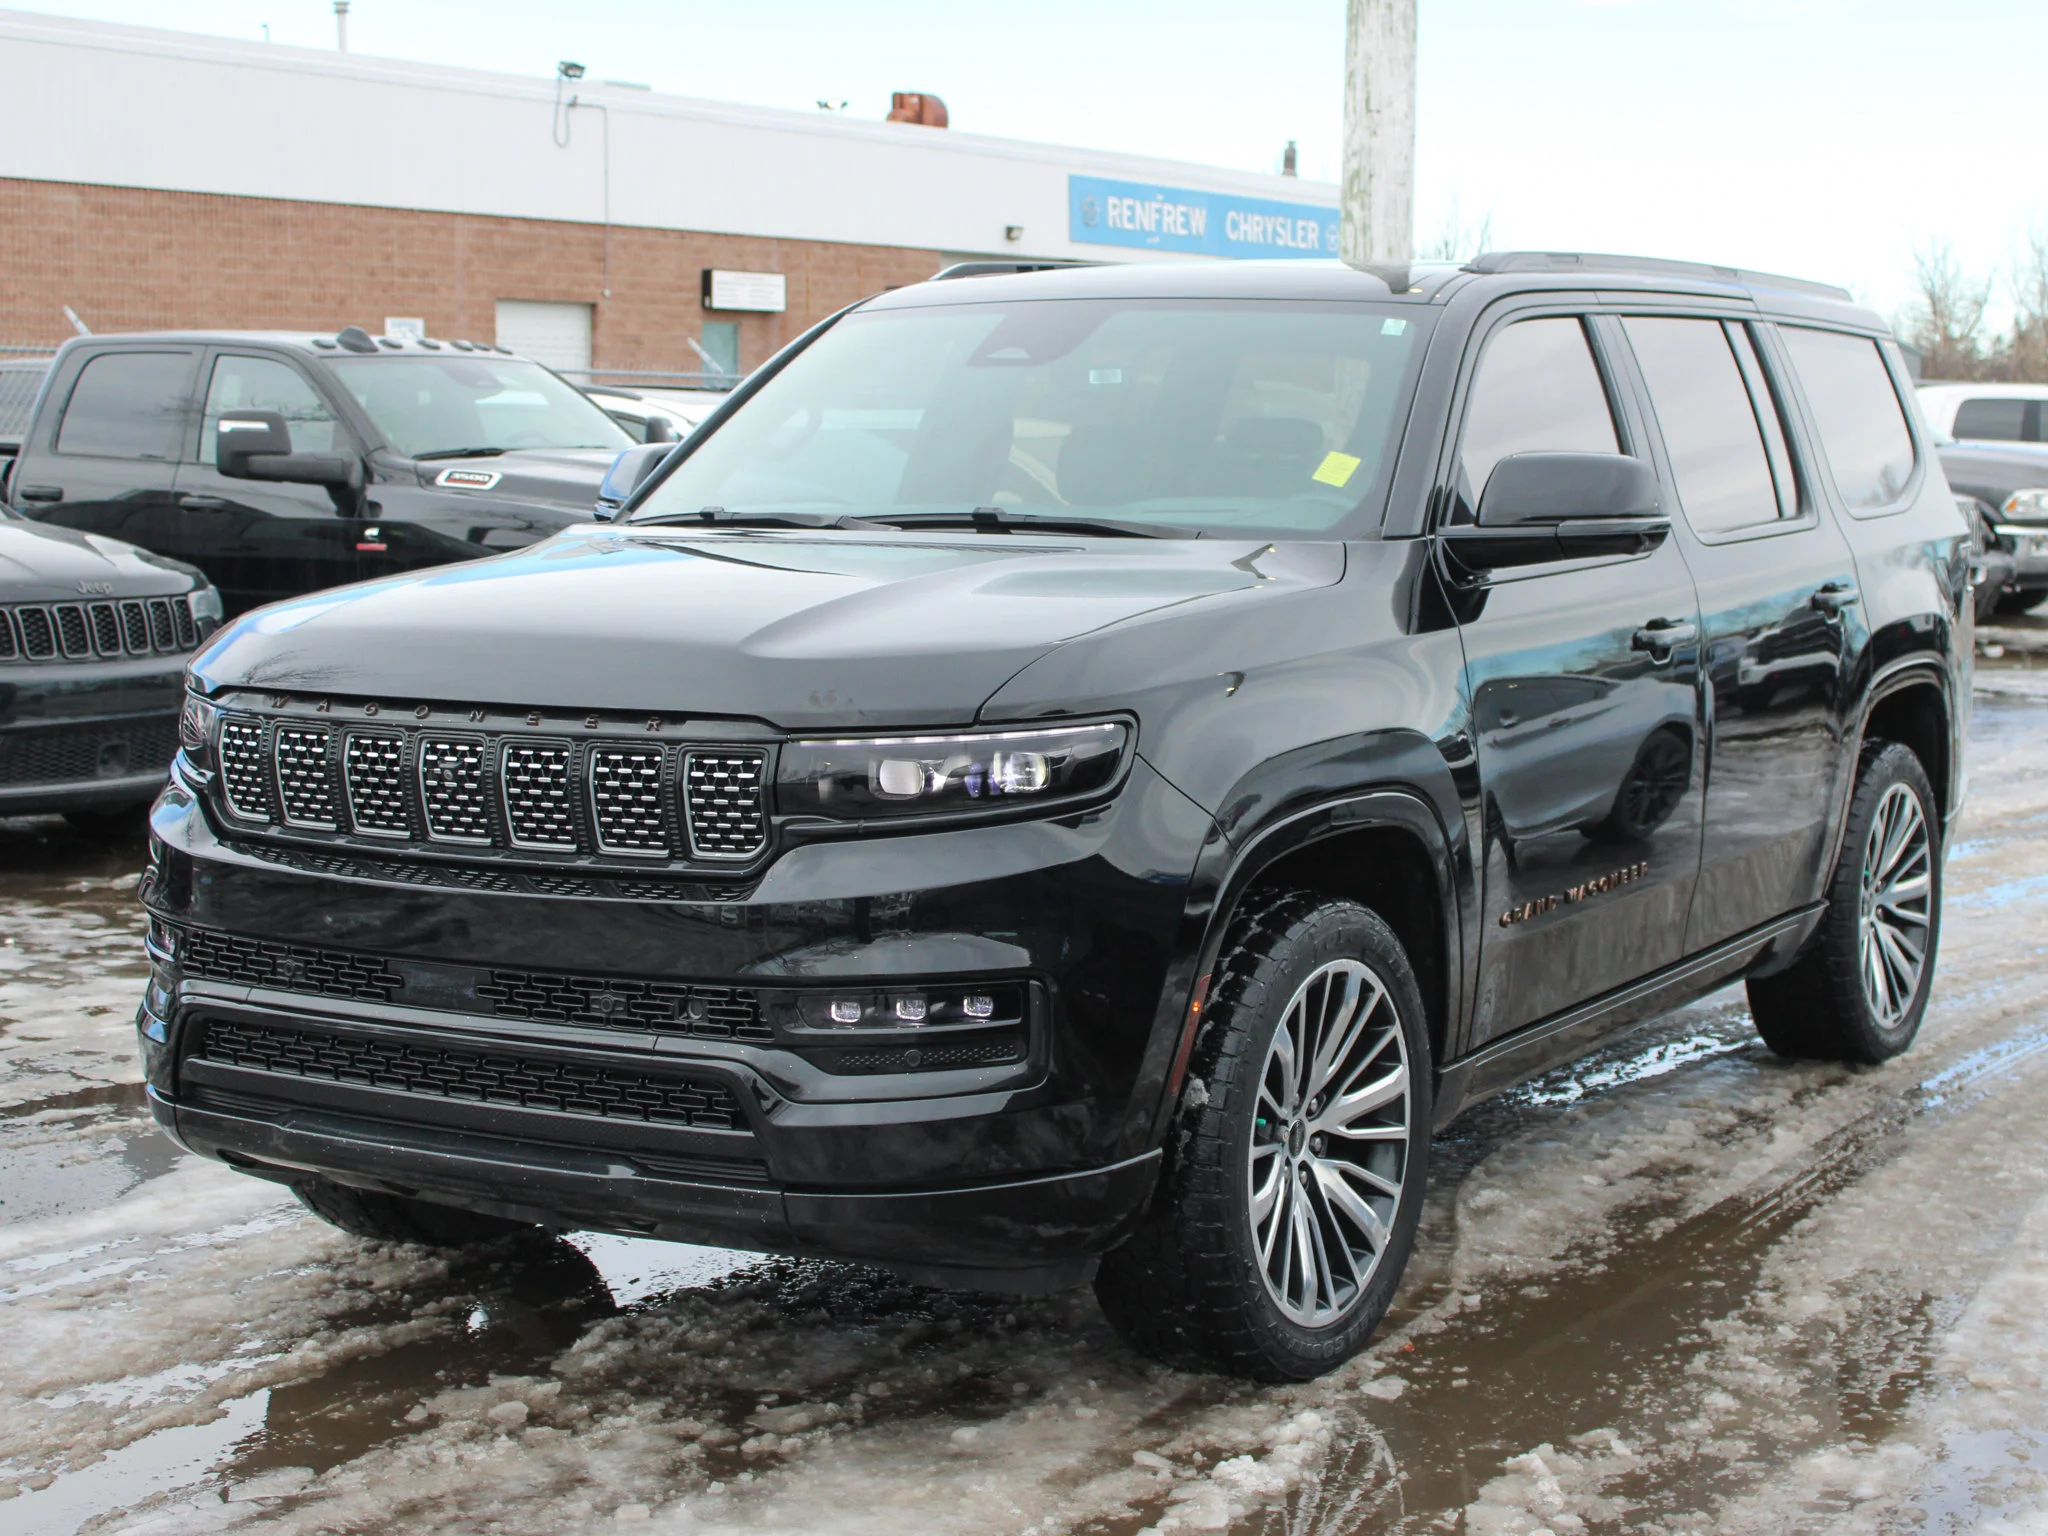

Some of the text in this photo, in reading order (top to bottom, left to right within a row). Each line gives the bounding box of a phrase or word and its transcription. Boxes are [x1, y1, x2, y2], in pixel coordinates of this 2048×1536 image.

[1107, 195, 1320, 250] RENFREW CHRYSLER
[76, 580, 113, 596] Jeep
[271, 696, 662, 732] WAGONEER
[1564, 861, 1649, 904] WAGONEER
